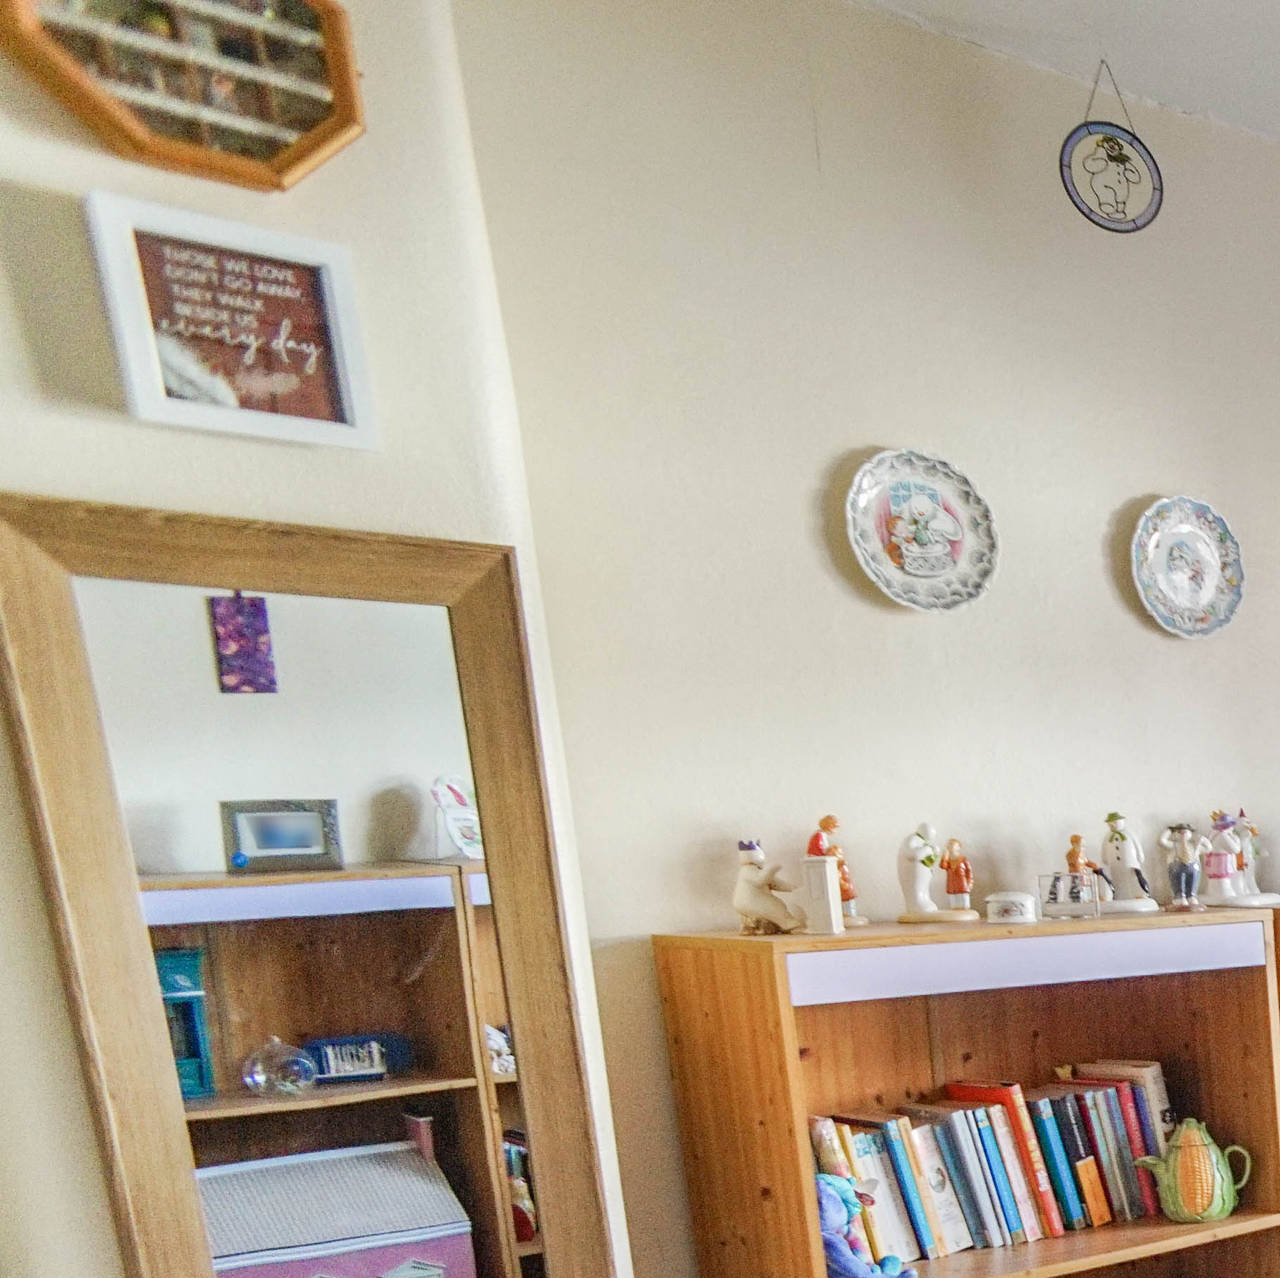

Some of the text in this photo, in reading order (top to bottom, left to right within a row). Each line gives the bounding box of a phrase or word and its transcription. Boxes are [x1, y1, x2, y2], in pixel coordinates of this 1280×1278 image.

[162, 246, 218, 268] THOSE
[223, 258, 250, 275] WE
[163, 263, 218, 286] DON'T
[223, 275, 252, 290] GO
[171, 283, 265, 312] THEY WALK
[173, 302, 258, 330] BESIDE US
[159, 318, 323, 374] every day
